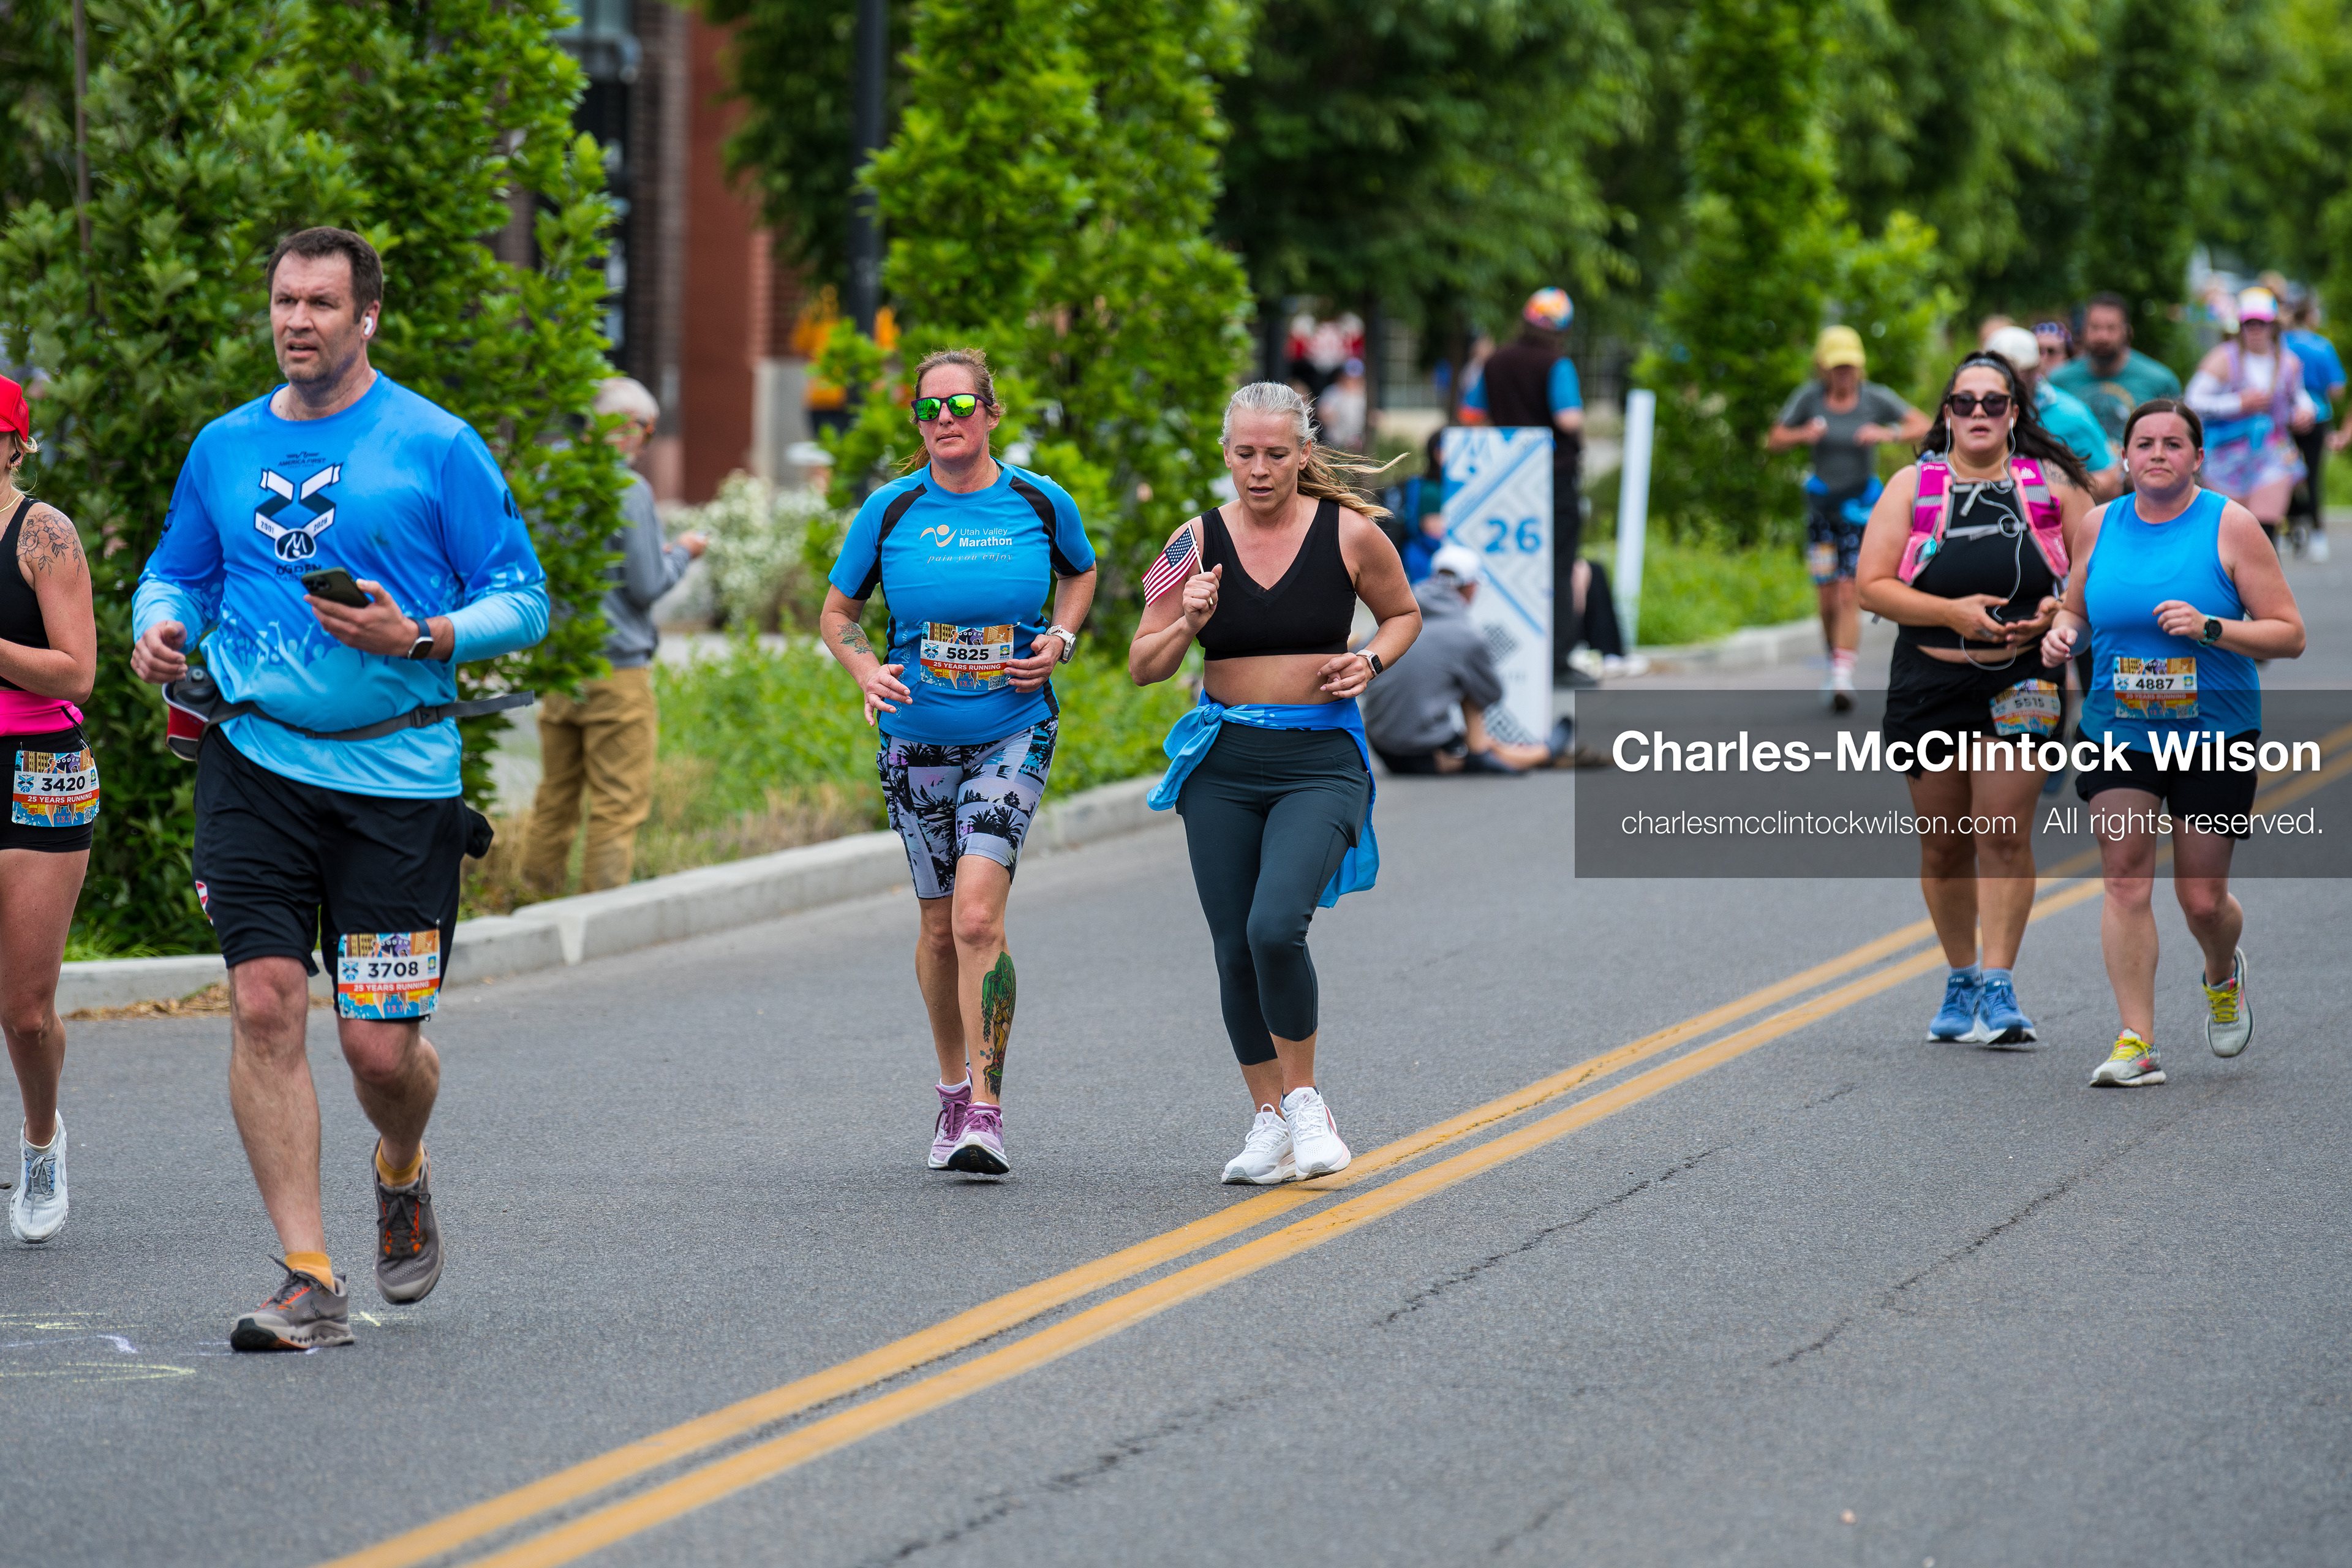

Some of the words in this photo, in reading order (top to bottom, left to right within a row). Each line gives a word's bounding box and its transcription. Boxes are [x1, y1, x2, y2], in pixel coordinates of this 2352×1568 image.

[277, 458, 305, 467] AMERICA
[1485, 516, 1543, 554] 26
[959, 537, 1012, 547] Marathon
[927, 554, 953, 564] pain
[982, 553, 1013, 562] enjoy
[946, 647, 989, 660] 5825
[2136, 678, 2175, 690] 4887
[41, 775, 86, 791] 3420
[67, 793, 92, 802] RUNNING
[368, 962, 418, 978] 3708
[396, 981, 430, 990] RUNNING
